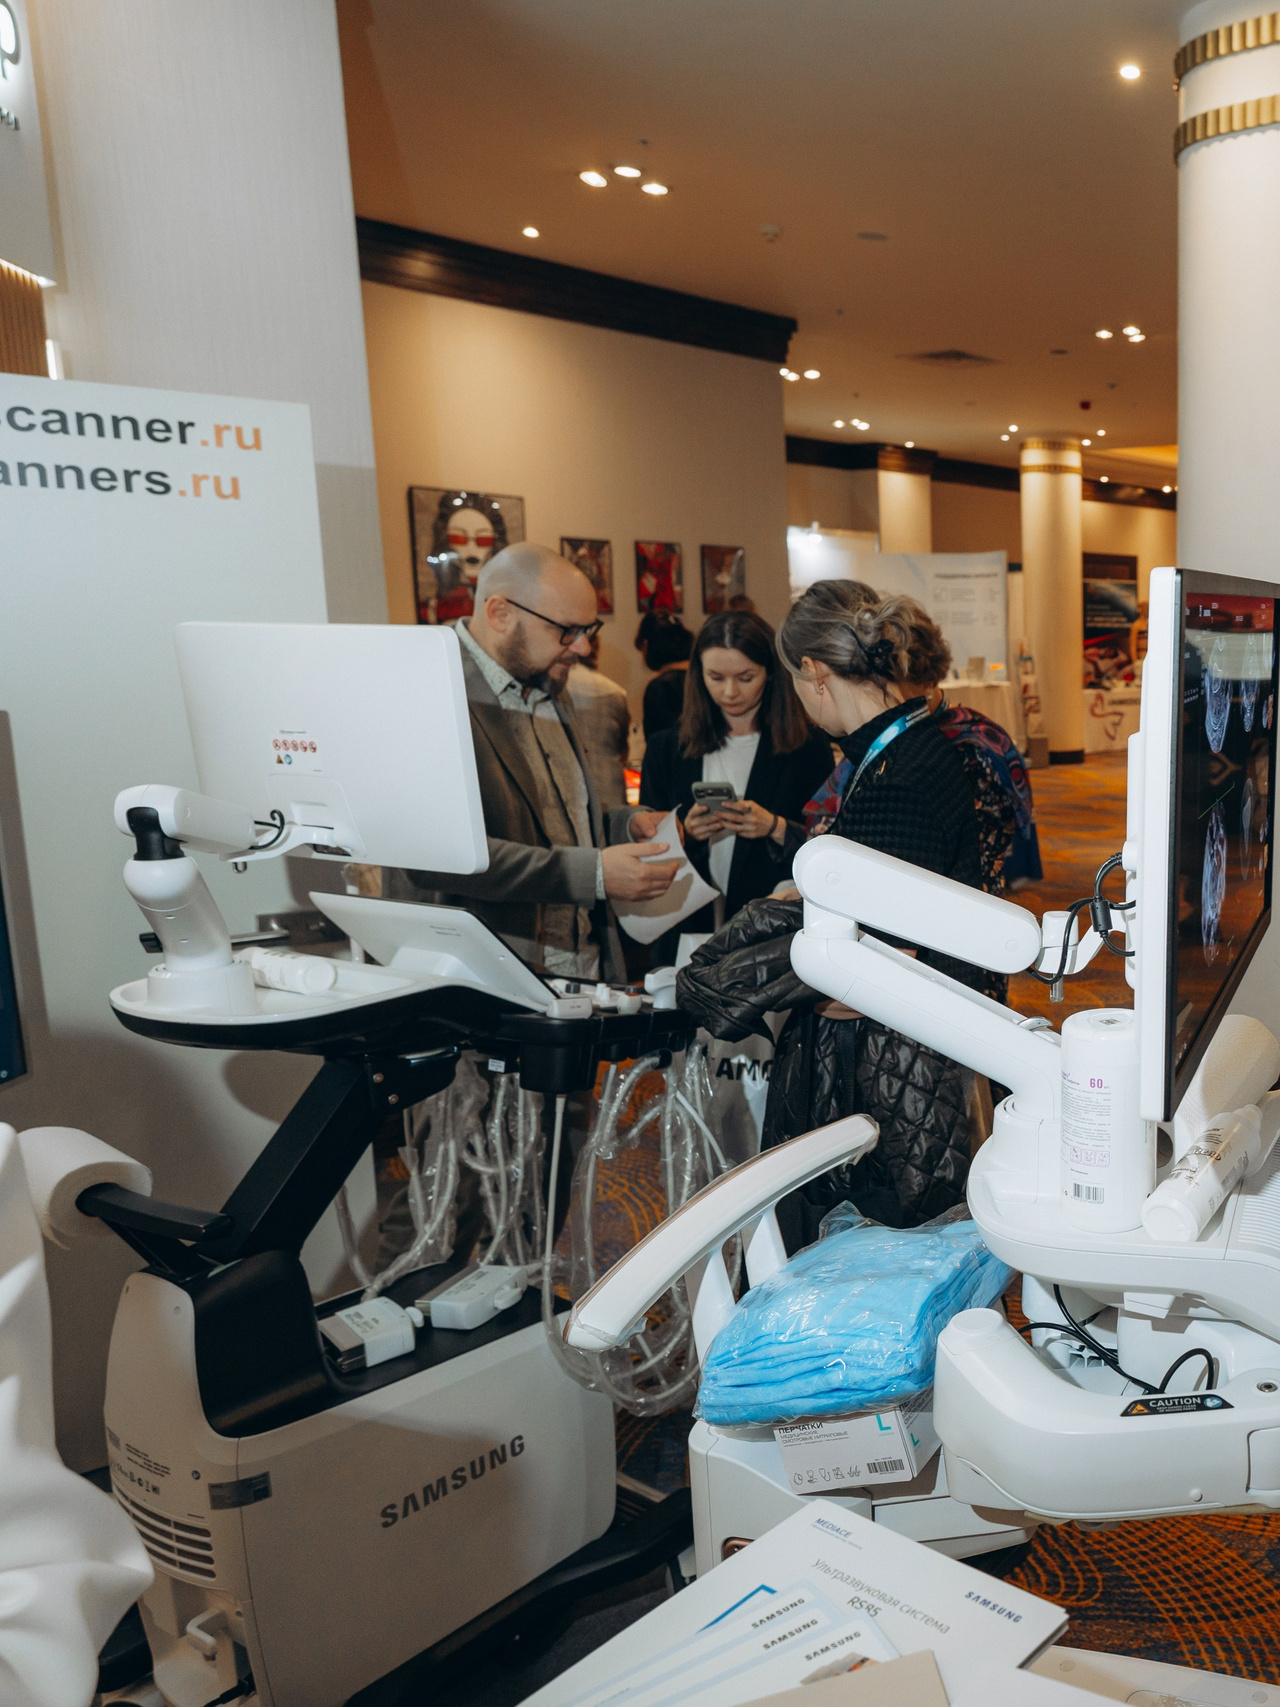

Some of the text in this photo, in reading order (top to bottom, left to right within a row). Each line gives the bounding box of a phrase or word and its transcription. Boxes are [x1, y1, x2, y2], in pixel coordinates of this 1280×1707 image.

[0, 405, 263, 452] canner.ru
[1090, 1078, 1103, 1089] 60
[1149, 1397, 1201, 1407] CAUTION
[778, 1422, 824, 1434] ПЕРЧАТКИ
[876, 1414, 892, 1431] L
[910, 1432, 920, 1447] L
[380, 1434, 525, 1529] SAMSUNG
[814, 1517, 853, 1539] MEDIACE
[811, 1558, 951, 1635] Ультразвуковая система
[965, 1591, 1023, 1624] SAMSUNG
[751, 1597, 805, 1630] SAMSUNG
[763, 1618, 818, 1651] SAMSUNG
[805, 1631, 861, 1662] SAMSUNG
